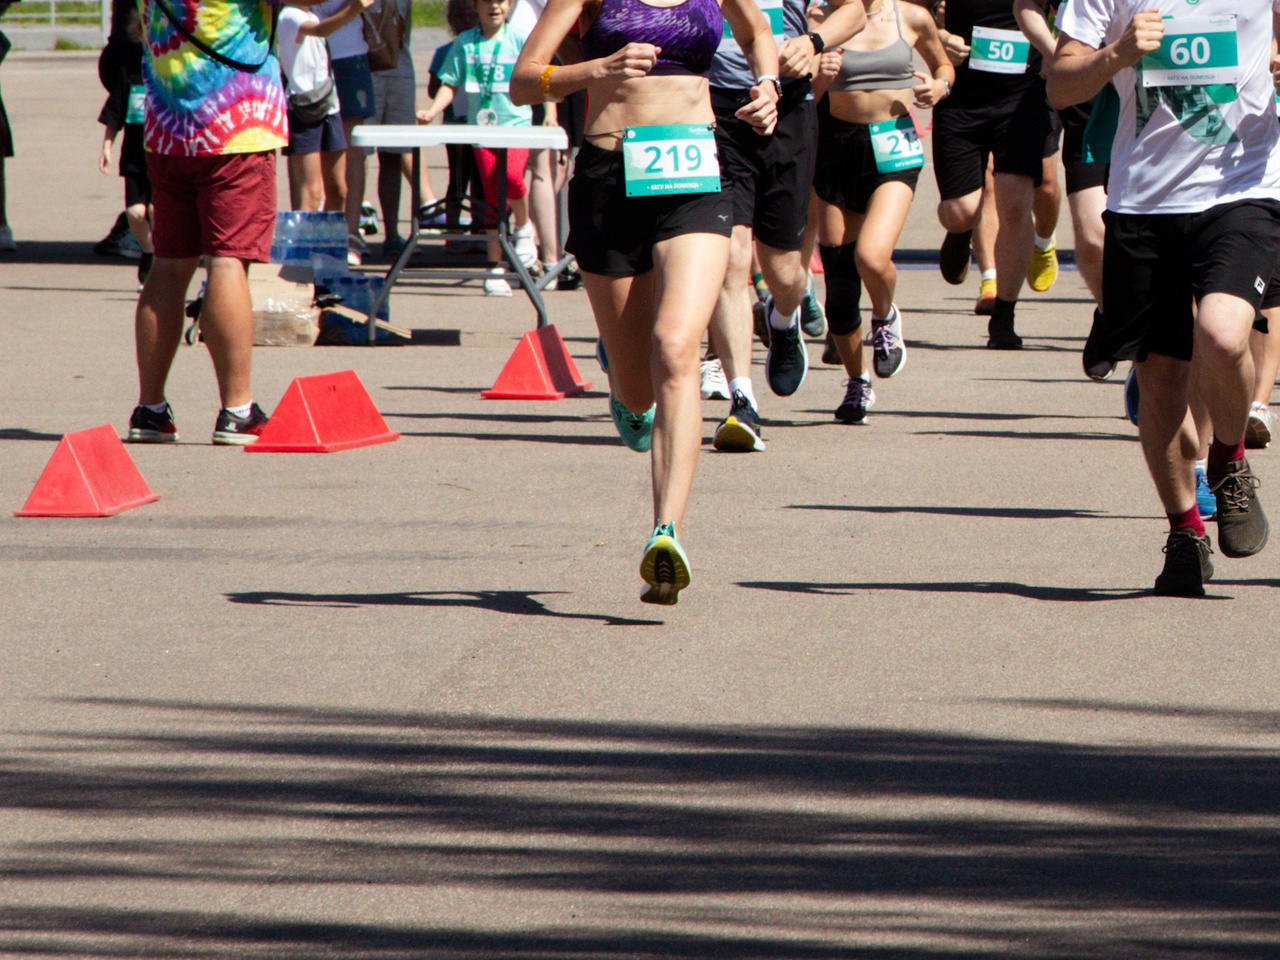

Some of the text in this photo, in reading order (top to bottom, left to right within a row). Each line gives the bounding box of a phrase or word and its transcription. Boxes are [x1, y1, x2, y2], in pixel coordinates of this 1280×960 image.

[988, 40, 1014, 61] 50
[1170, 36, 1211, 66] 60
[644, 144, 702, 173] 219
